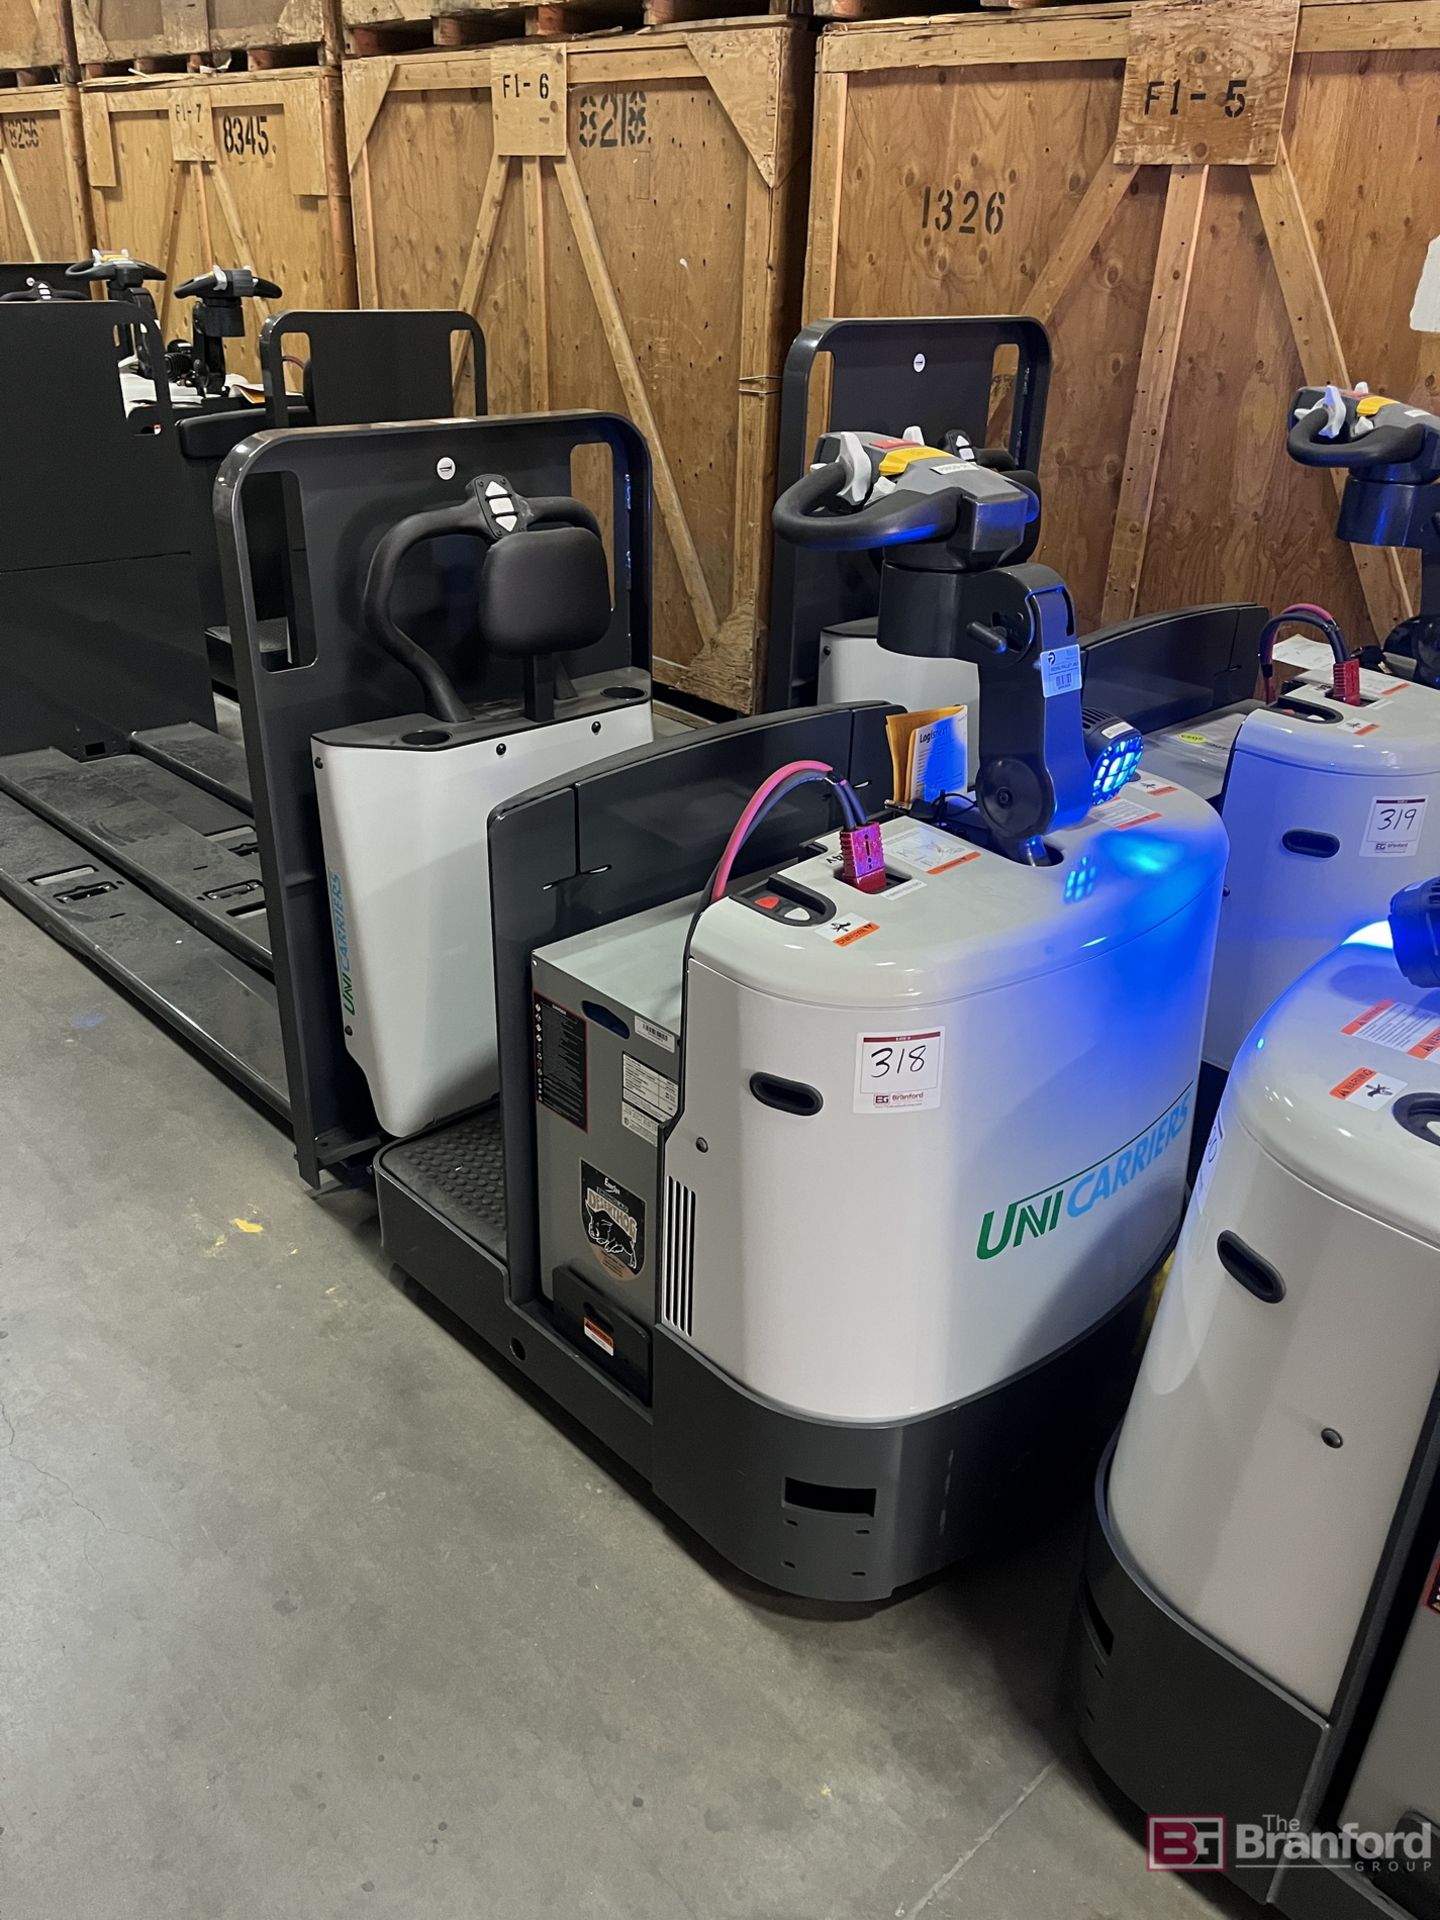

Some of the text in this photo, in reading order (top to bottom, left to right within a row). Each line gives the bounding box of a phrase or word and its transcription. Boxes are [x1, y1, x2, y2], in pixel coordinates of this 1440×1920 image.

[223, 115, 269, 156] 8345
[579, 90, 647, 148] 8218
[922, 186, 1006, 235] 1326
[1377, 808, 1417, 831] 319
[871, 1044, 926, 1078] 318
